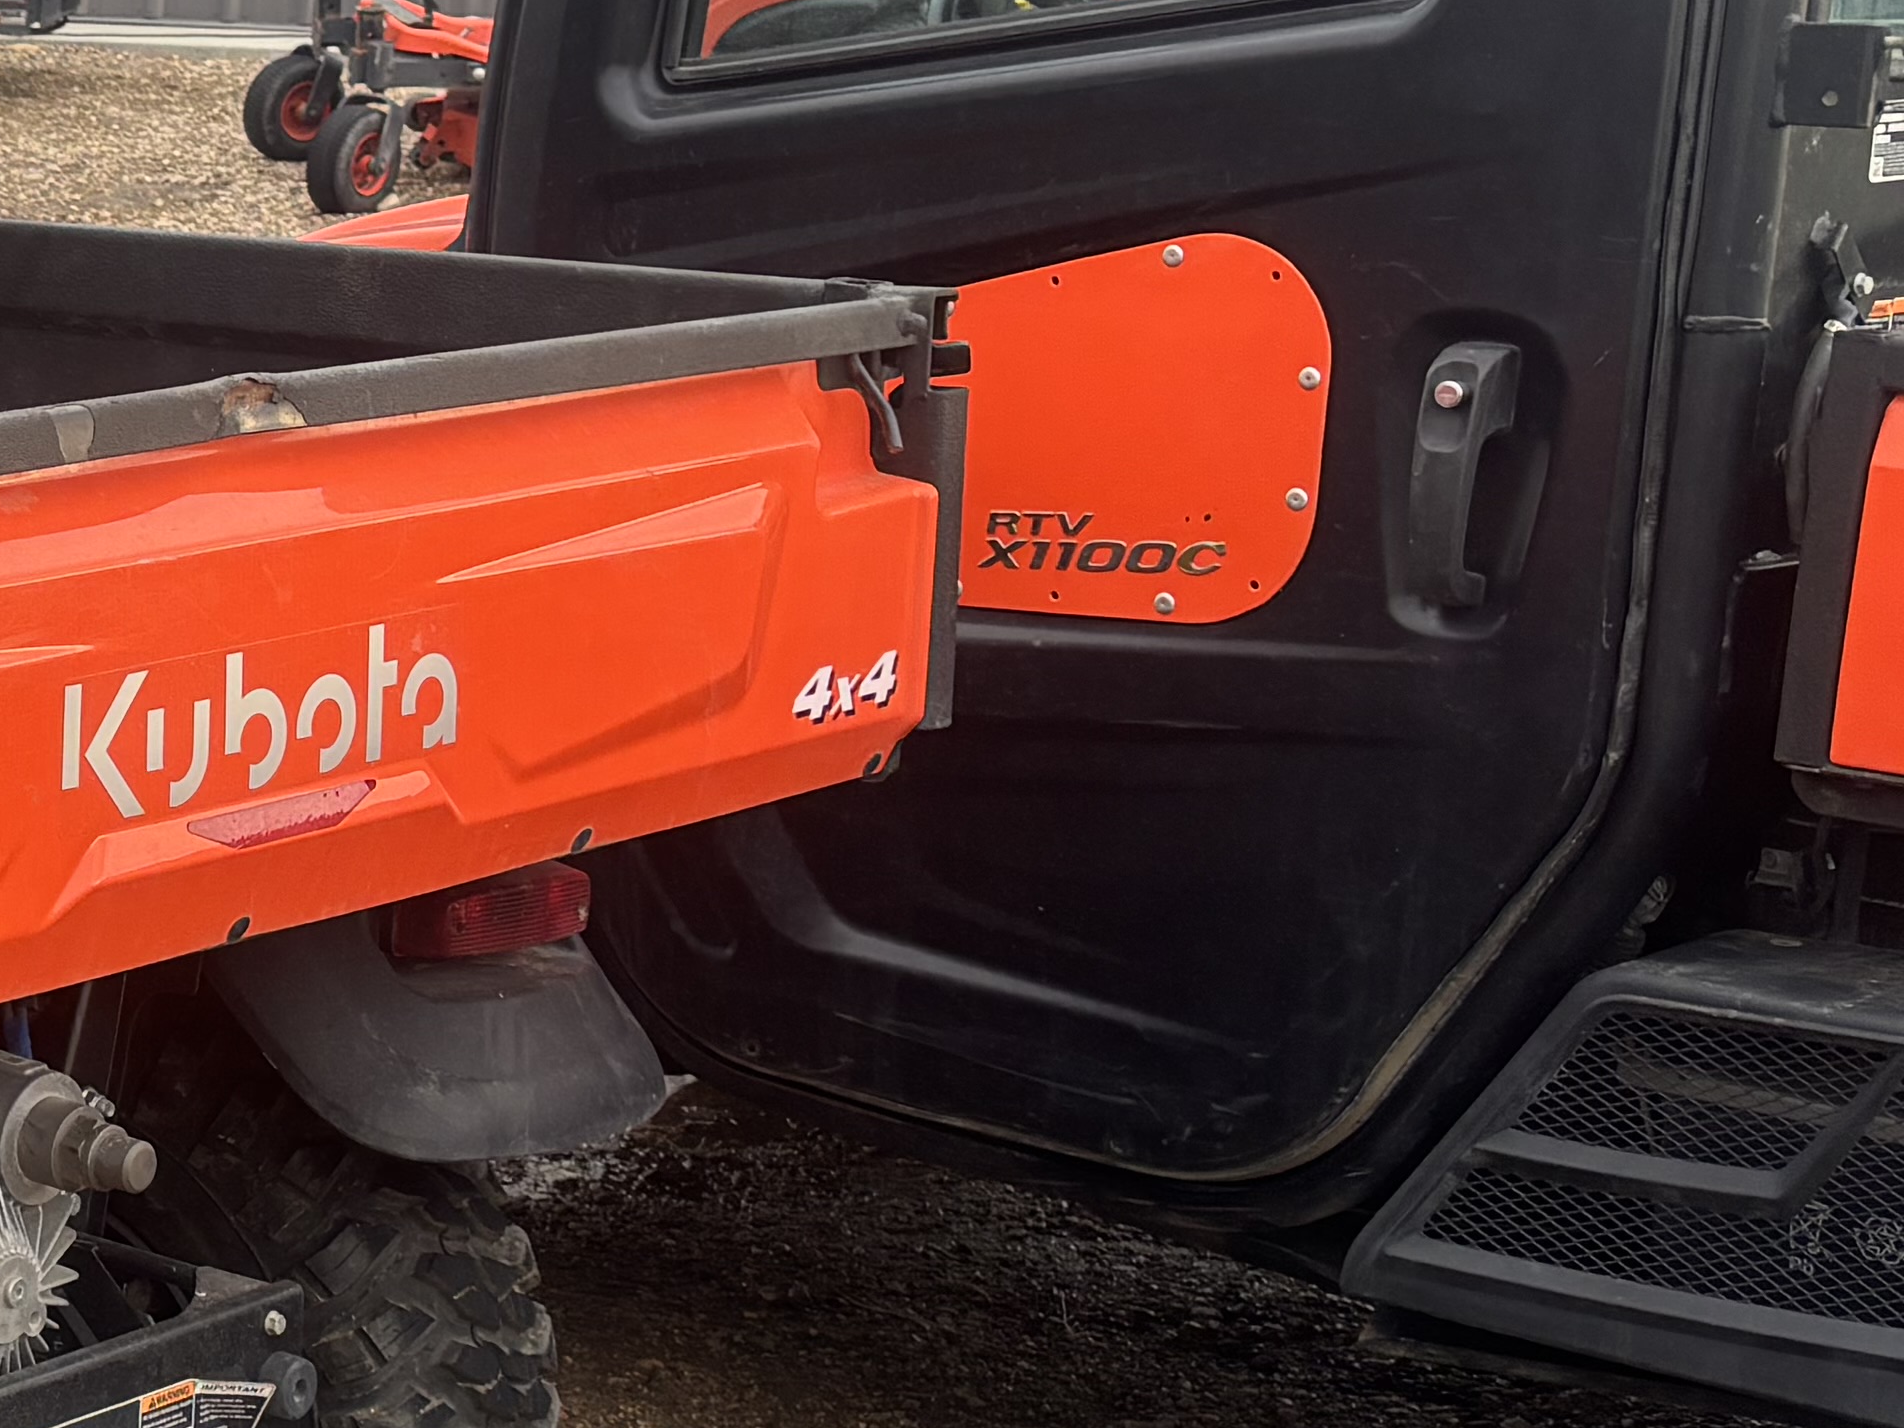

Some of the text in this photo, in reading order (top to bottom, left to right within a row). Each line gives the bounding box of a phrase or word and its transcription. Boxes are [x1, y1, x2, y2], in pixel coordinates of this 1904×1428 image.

[986, 510, 1093, 536] RTV
[977, 539, 1227, 575] X1100C
[791, 649, 898, 724] 4x4
[61, 622, 458, 819] Kubota
[156, 1385, 190, 1407] WARNING
[200, 1383, 266, 1394] IMPORTANT
